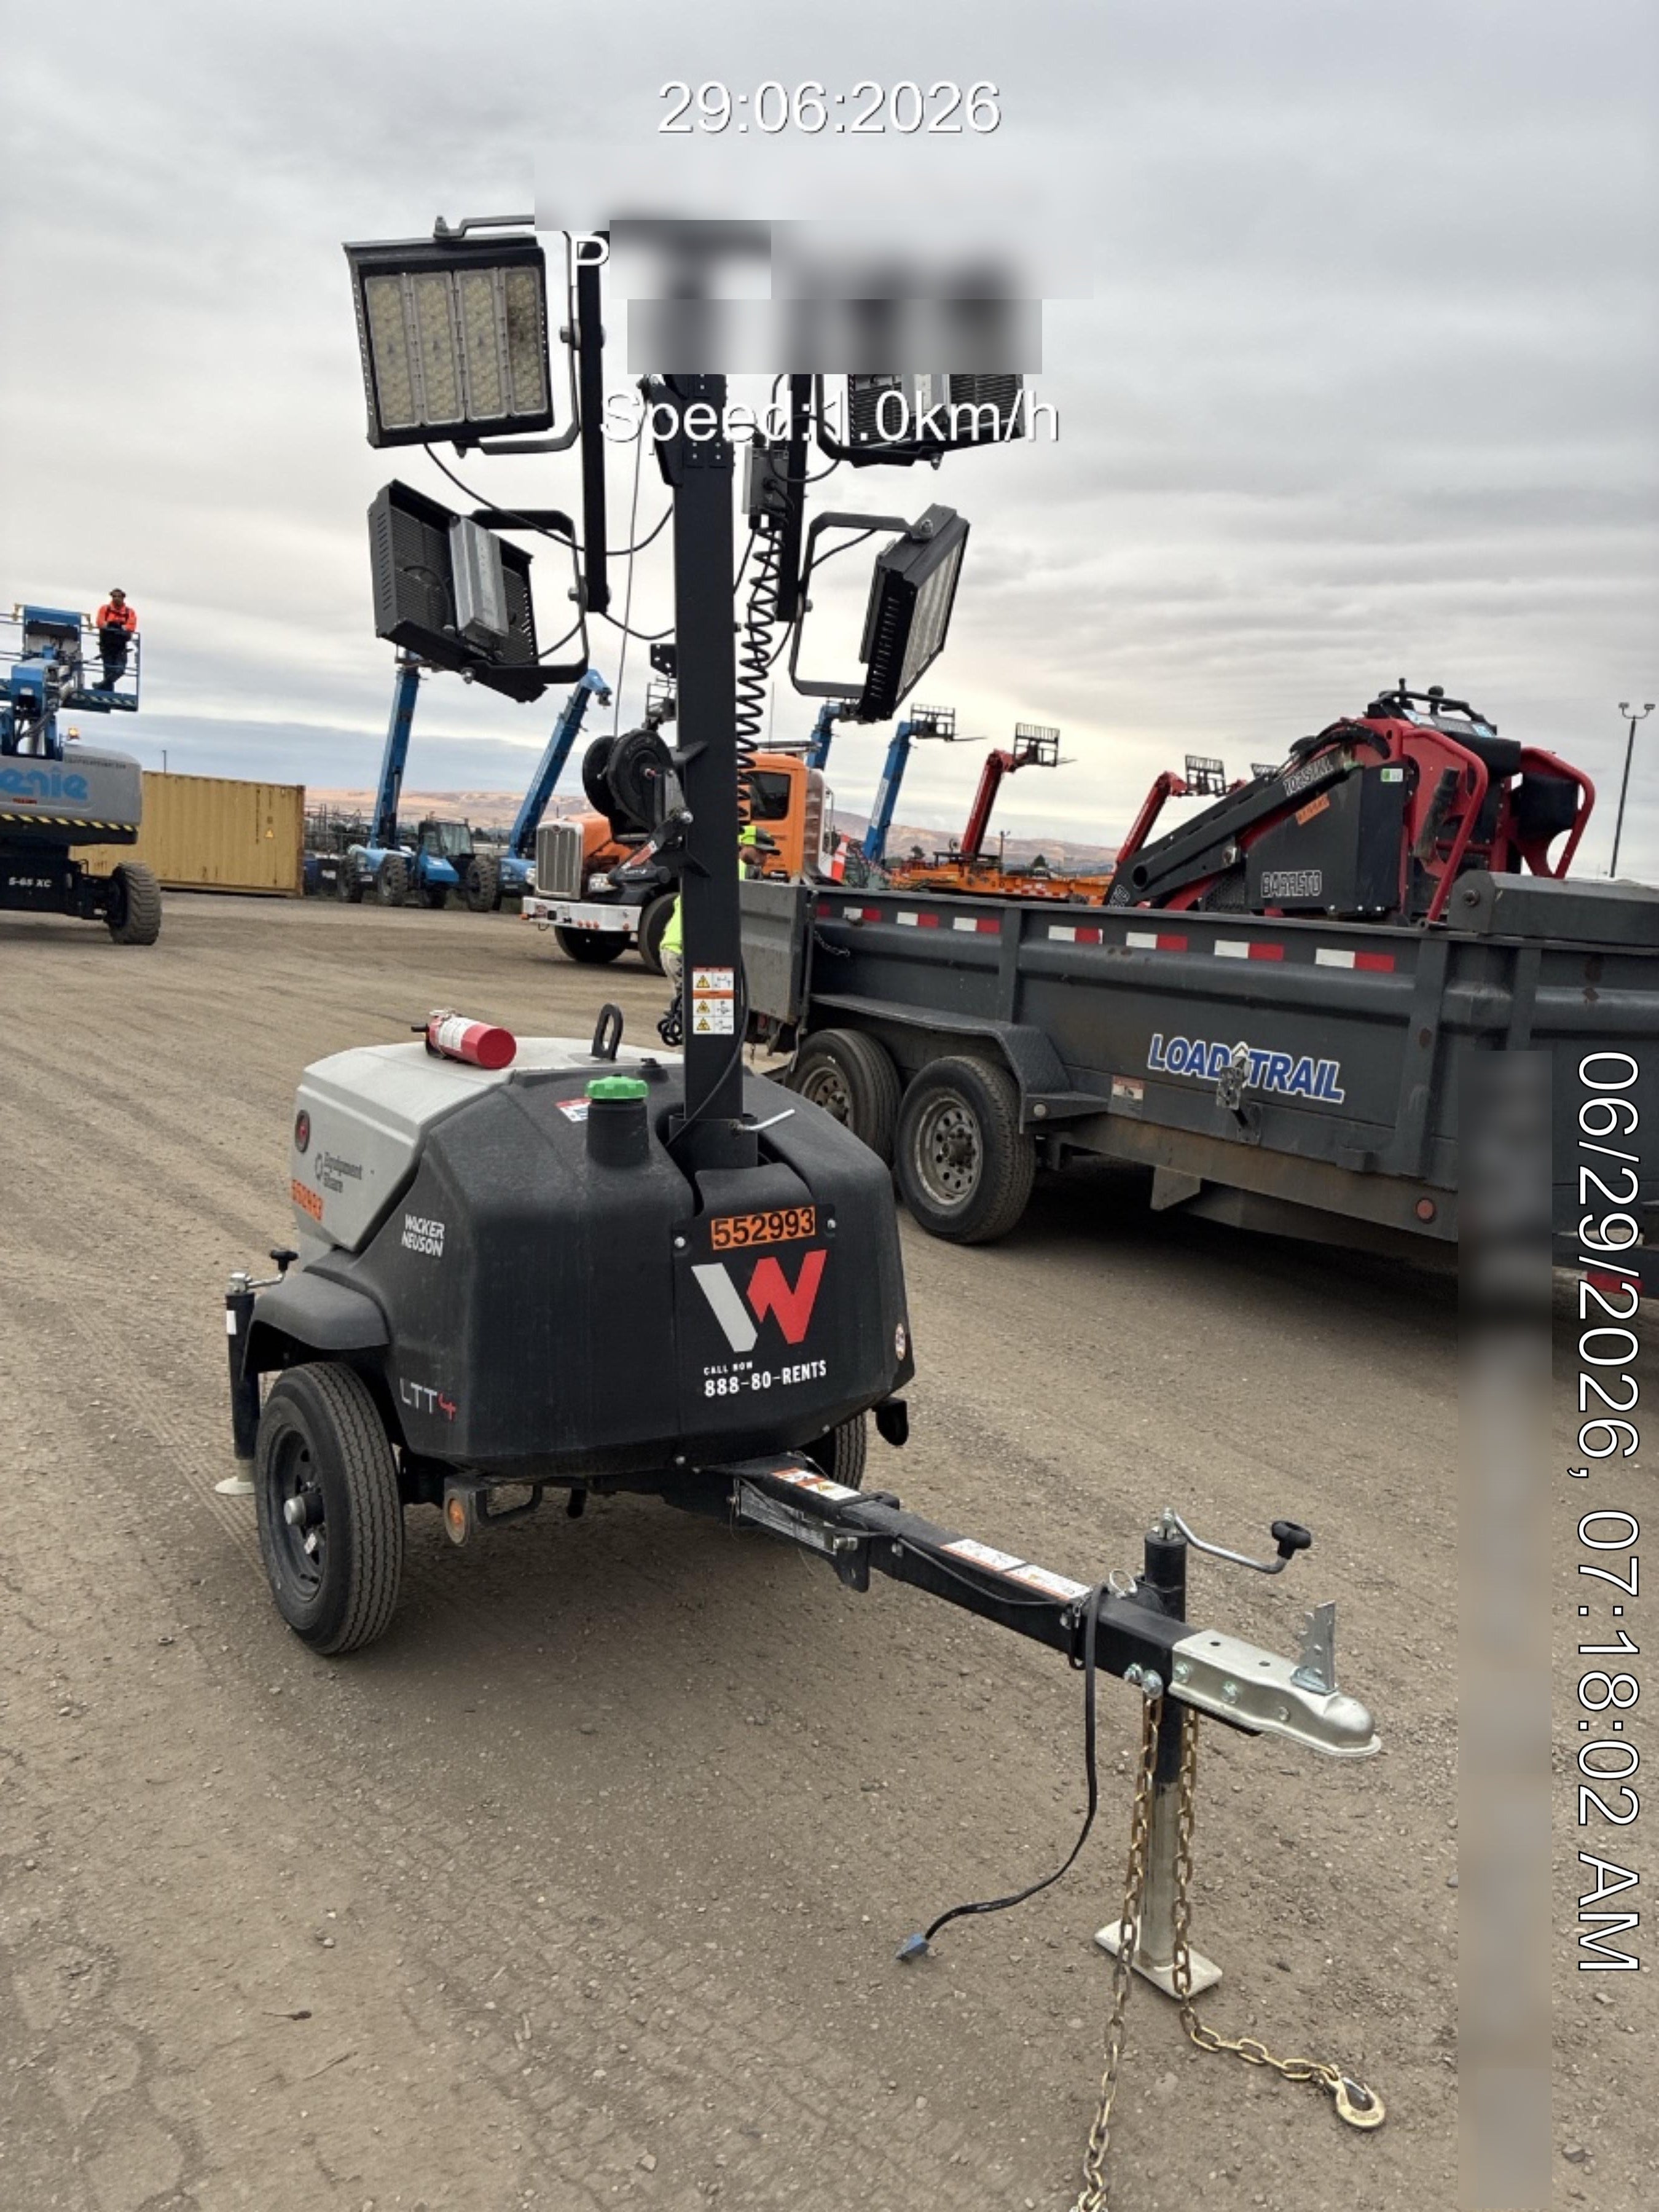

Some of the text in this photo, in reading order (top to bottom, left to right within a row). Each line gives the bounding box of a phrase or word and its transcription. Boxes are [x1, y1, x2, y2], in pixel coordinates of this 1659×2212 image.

[0, 766, 88, 801] enie
[1261, 869, 1322, 898] BARRETO
[1147, 1033, 1345, 1105] LOAD TRAIL
[401, 1230, 444, 1258] NEUSON
[404, 1214, 445, 1240] WACKER
[713, 1209, 814, 1247] 552993
[704, 1363, 729, 1376] CALL
[704, 1359, 827, 1398] 888-80-RENTS
[399, 1377, 457, 1421] LTT4
